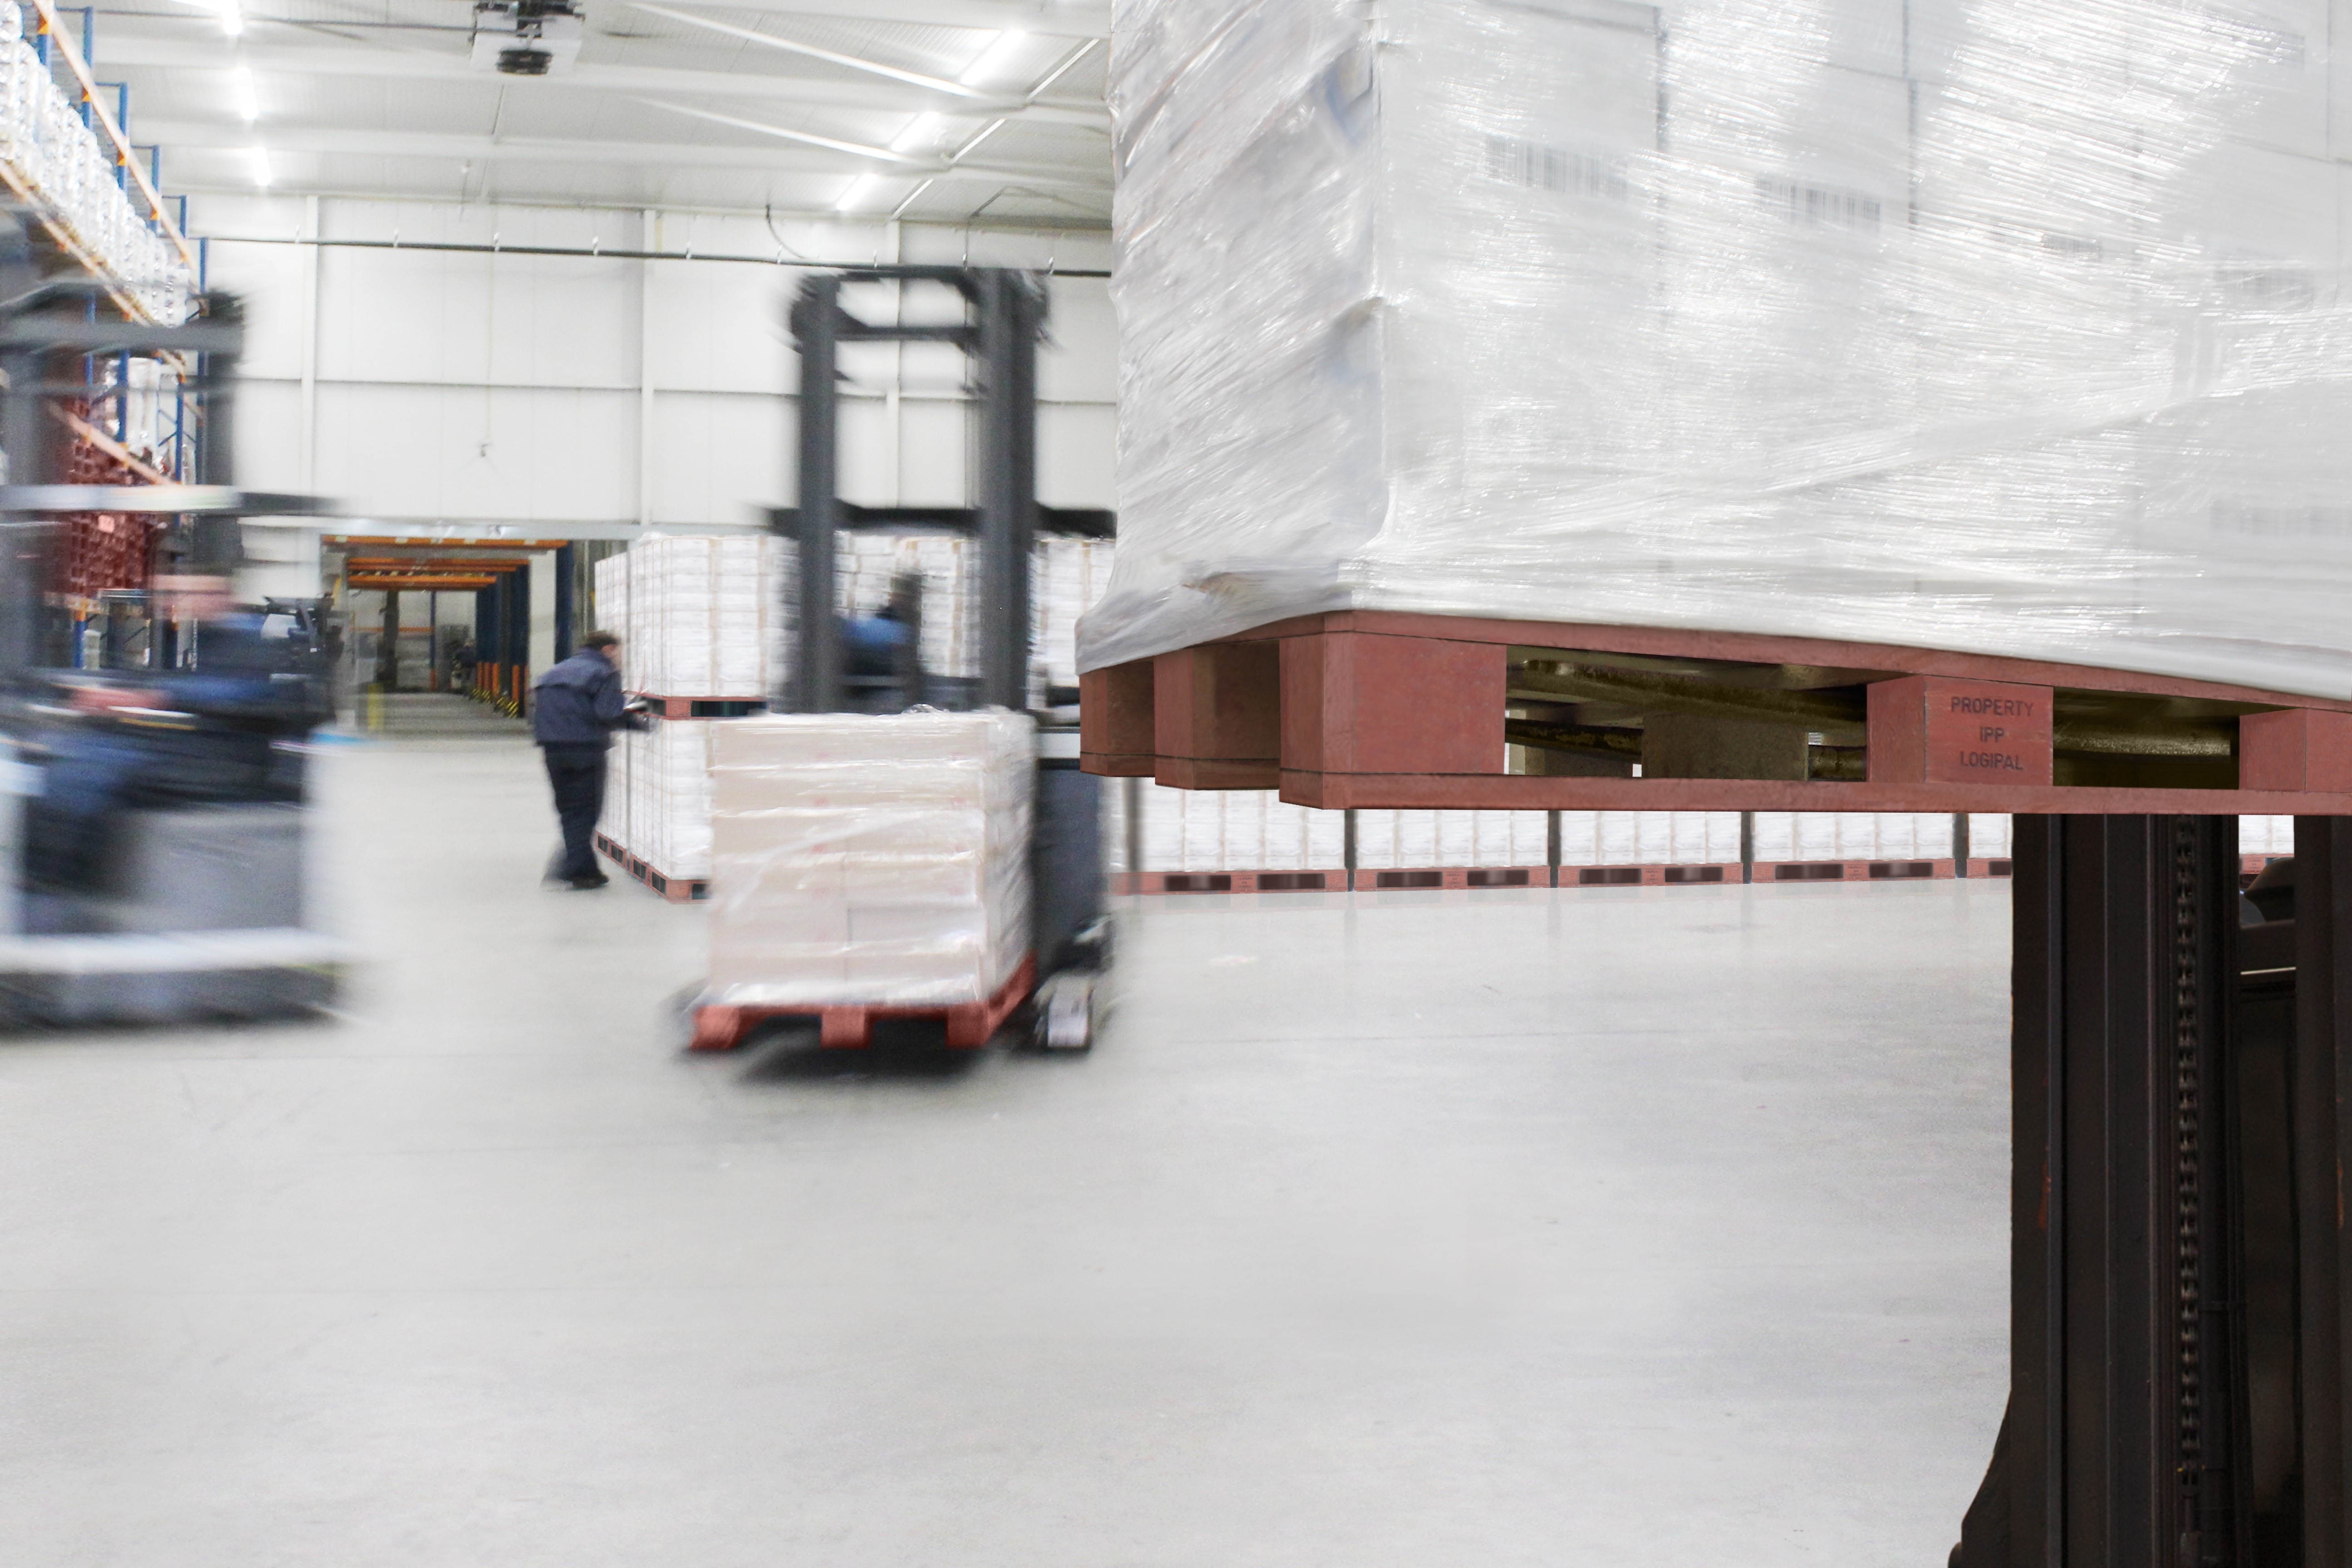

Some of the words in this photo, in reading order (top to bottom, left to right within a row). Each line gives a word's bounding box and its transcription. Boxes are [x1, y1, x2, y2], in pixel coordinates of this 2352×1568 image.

[1951, 696, 2034, 716] PROPERTY
[1980, 727, 2005, 743] IPP
[1960, 751, 2024, 770] LOGIPAL
